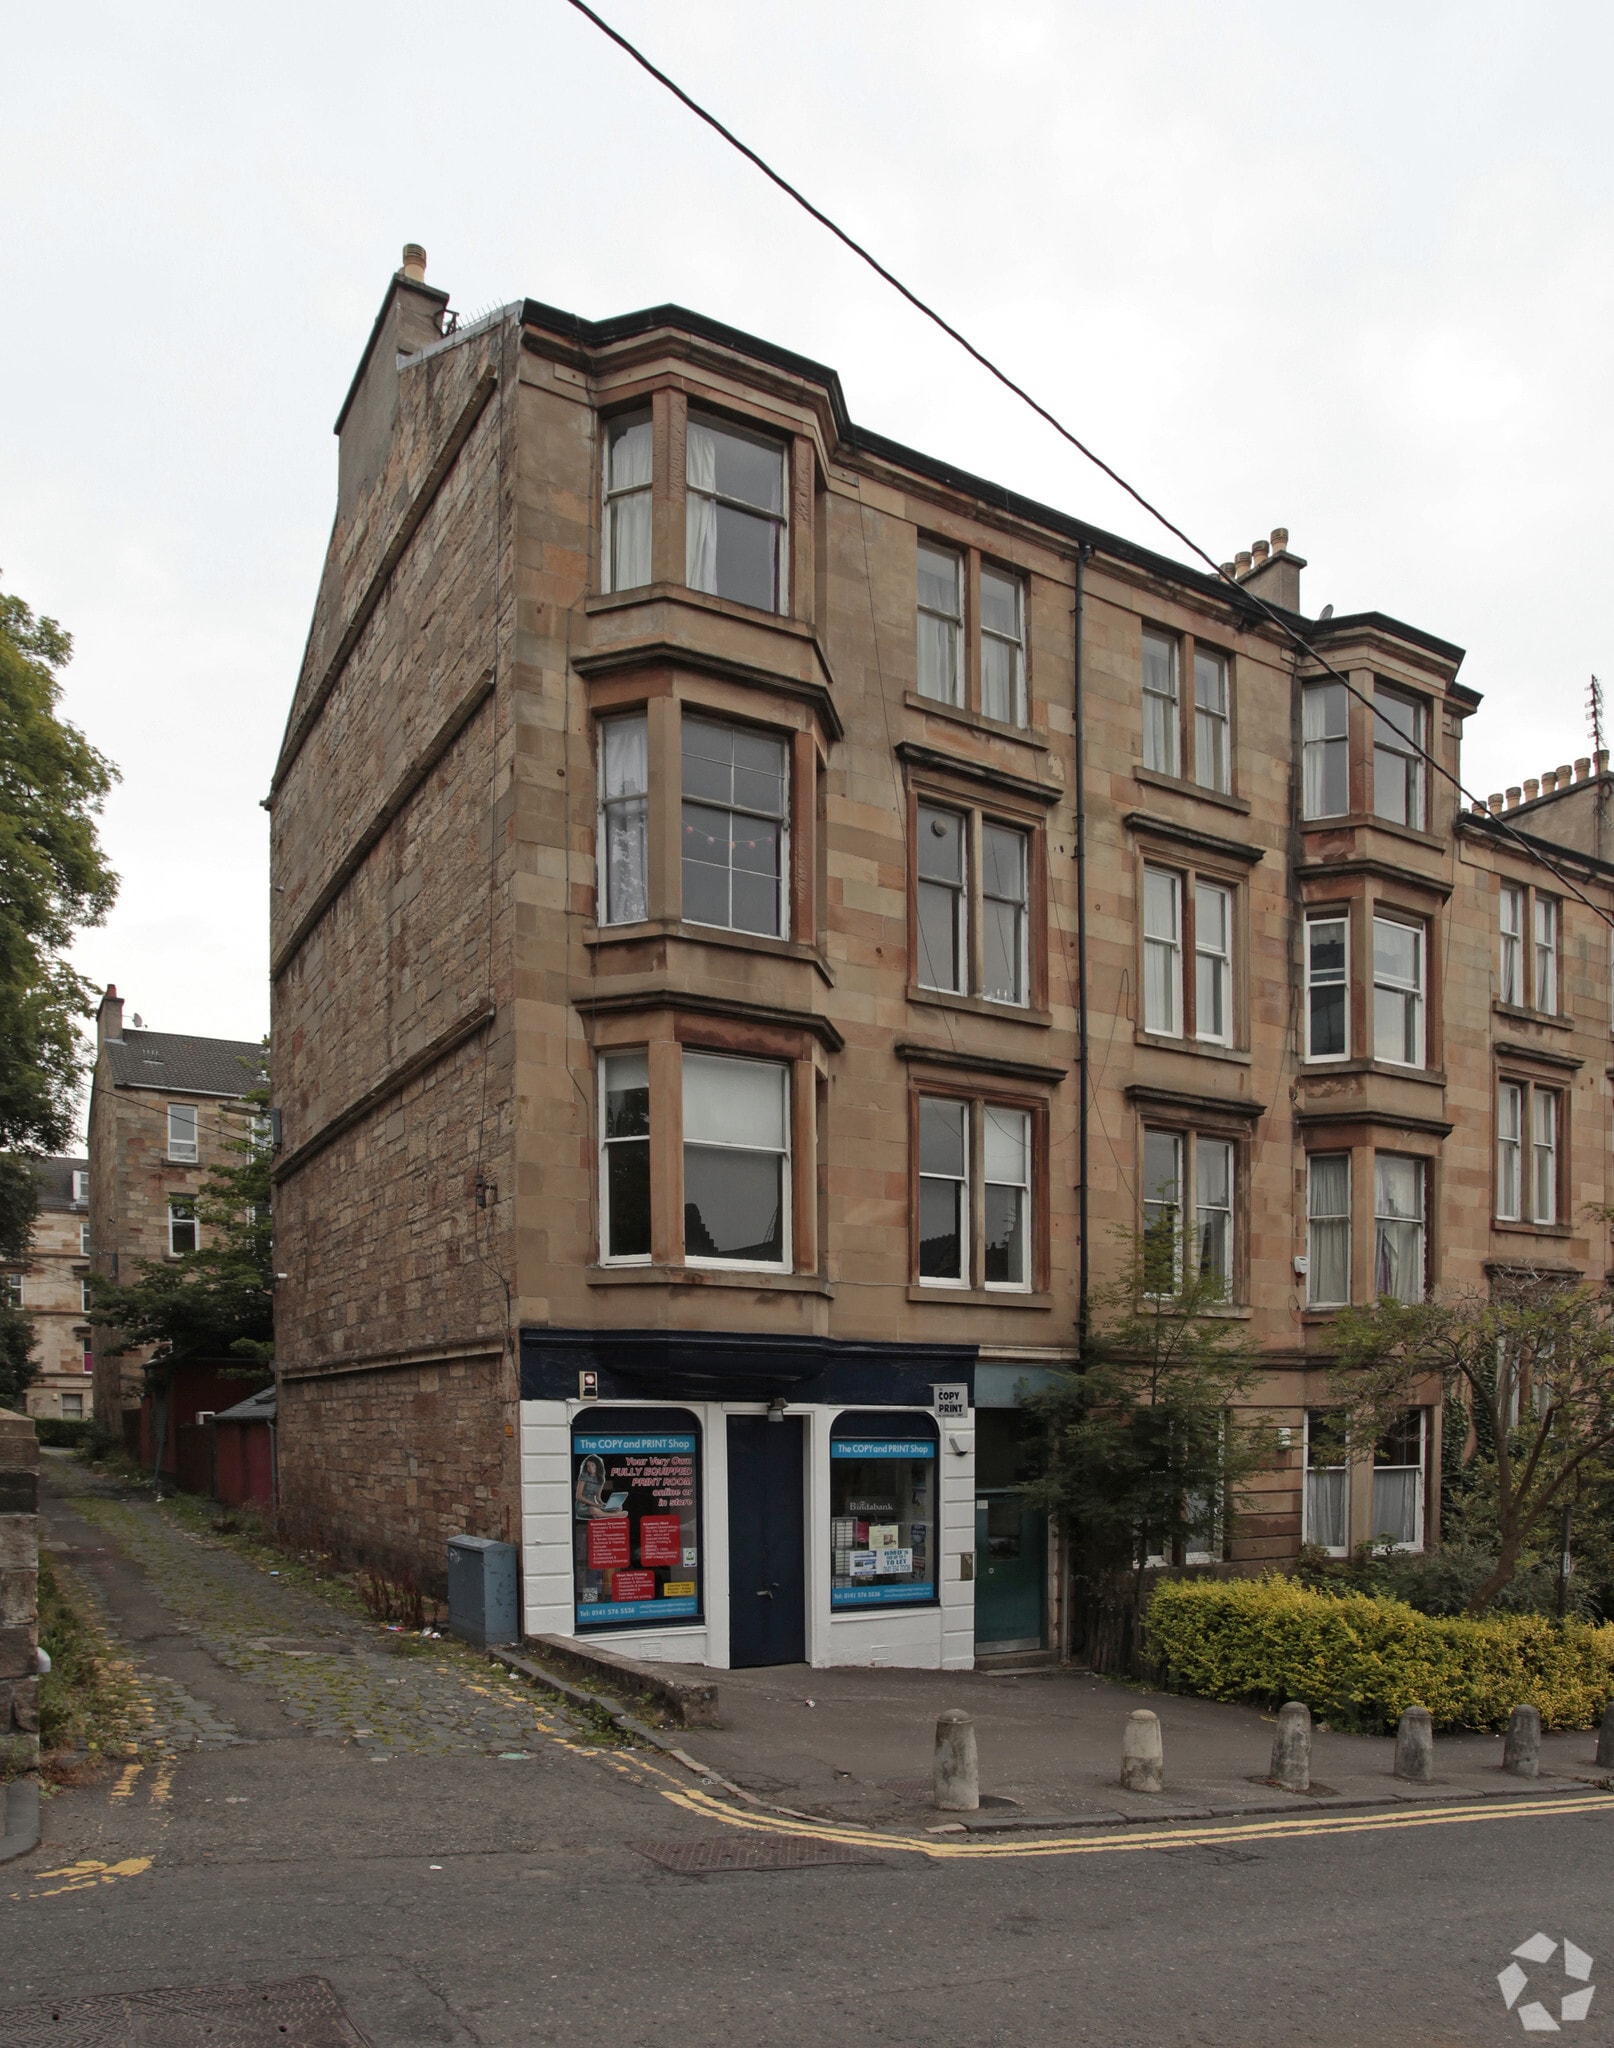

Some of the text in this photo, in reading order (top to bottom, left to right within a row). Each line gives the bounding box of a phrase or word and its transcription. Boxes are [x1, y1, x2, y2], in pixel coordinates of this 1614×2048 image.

[938, 1391, 959, 1400] COPY
[939, 1404, 963, 1413] PRINT
[580, 1439, 689, 1450] The COPY and PRINT Shop
[838, 1445, 852, 1453] The
[852, 1445, 873, 1453] COPY
[873, 1445, 887, 1453] and
[910, 1445, 928, 1454] Shop
[625, 1456, 692, 1467] Your Very Own
[610, 1467, 692, 1477] FULLY EQUIPPED
[632, 1477, 693, 1487] PRINT ROOM
[652, 1488, 681, 1496] online
[658, 1498, 693, 1507] in store
[850, 1502, 893, 1511] Bindabank
